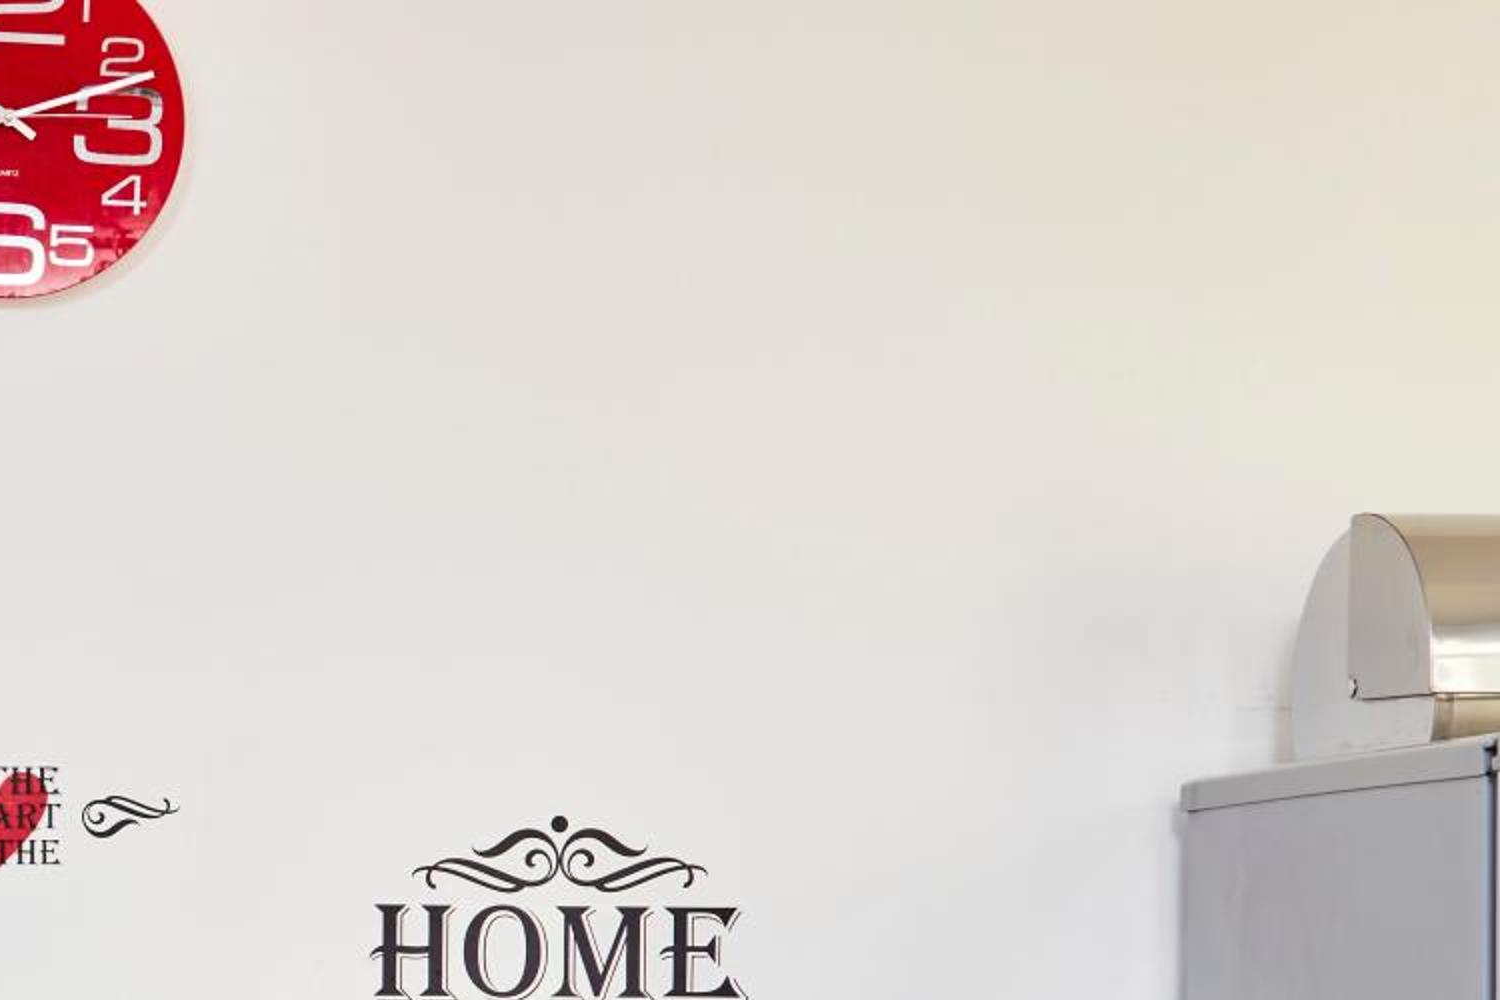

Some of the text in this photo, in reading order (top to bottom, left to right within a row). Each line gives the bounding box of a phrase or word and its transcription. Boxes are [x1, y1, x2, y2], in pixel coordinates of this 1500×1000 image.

[100, 37, 146, 78] 2
[73, 85, 164, 167] 3
[101, 175, 148, 216] 4
[48, 225, 95, 267] 5
